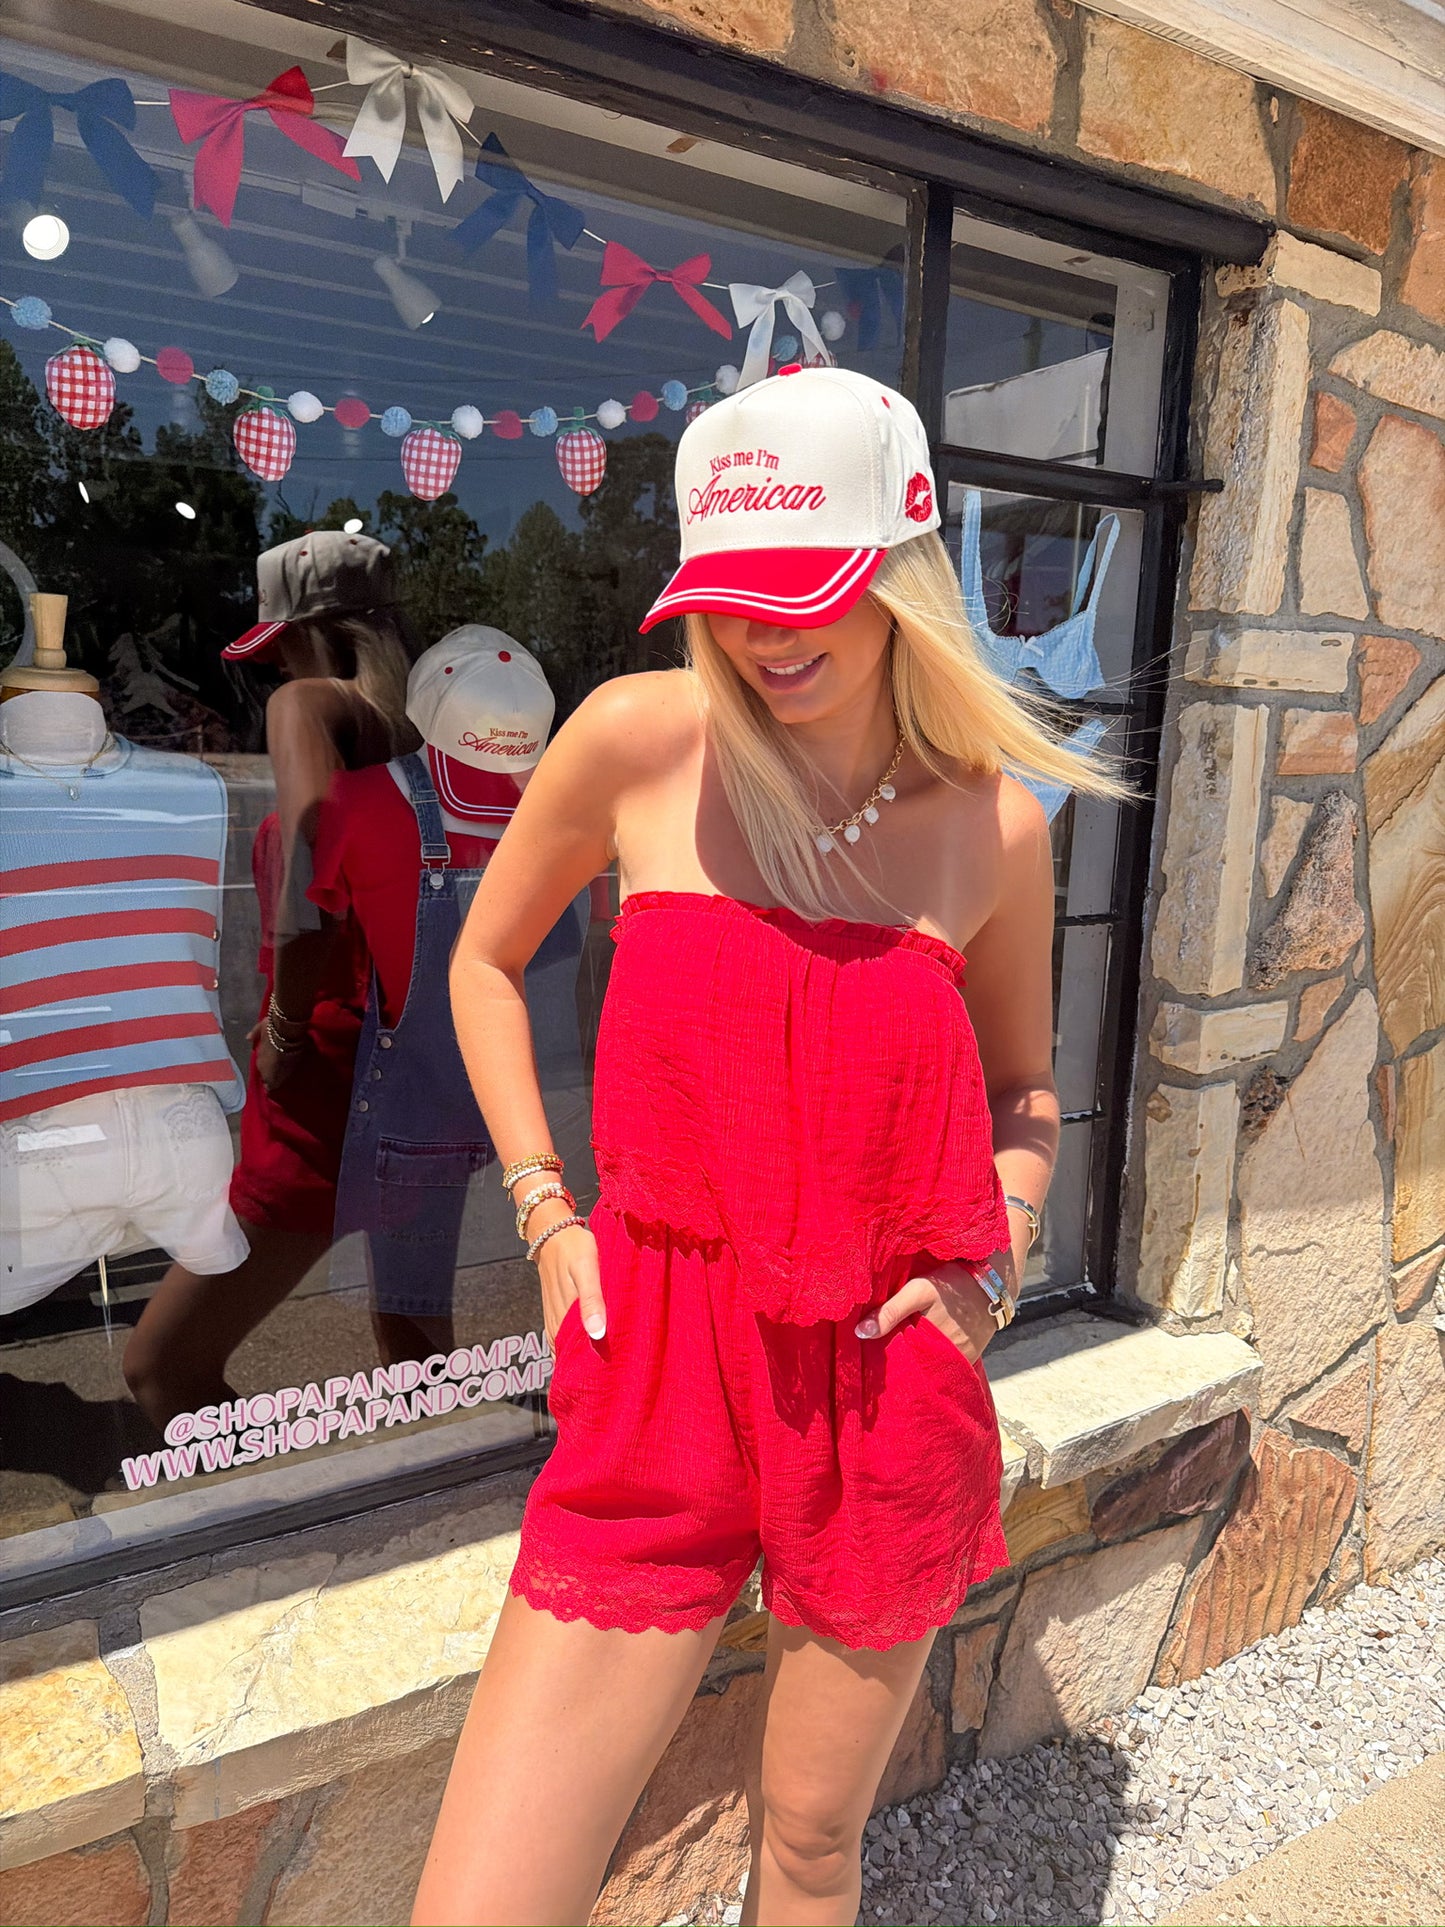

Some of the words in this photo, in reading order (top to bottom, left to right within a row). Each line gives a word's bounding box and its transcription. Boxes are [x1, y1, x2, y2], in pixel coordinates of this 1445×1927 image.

[709, 455, 731, 475] Kiss
[733, 451, 753, 466] me
[756, 449, 779, 469] I'm
[687, 475, 826, 524] American
[458, 732, 539, 756] American
[490, 728, 505, 737] Kiss
